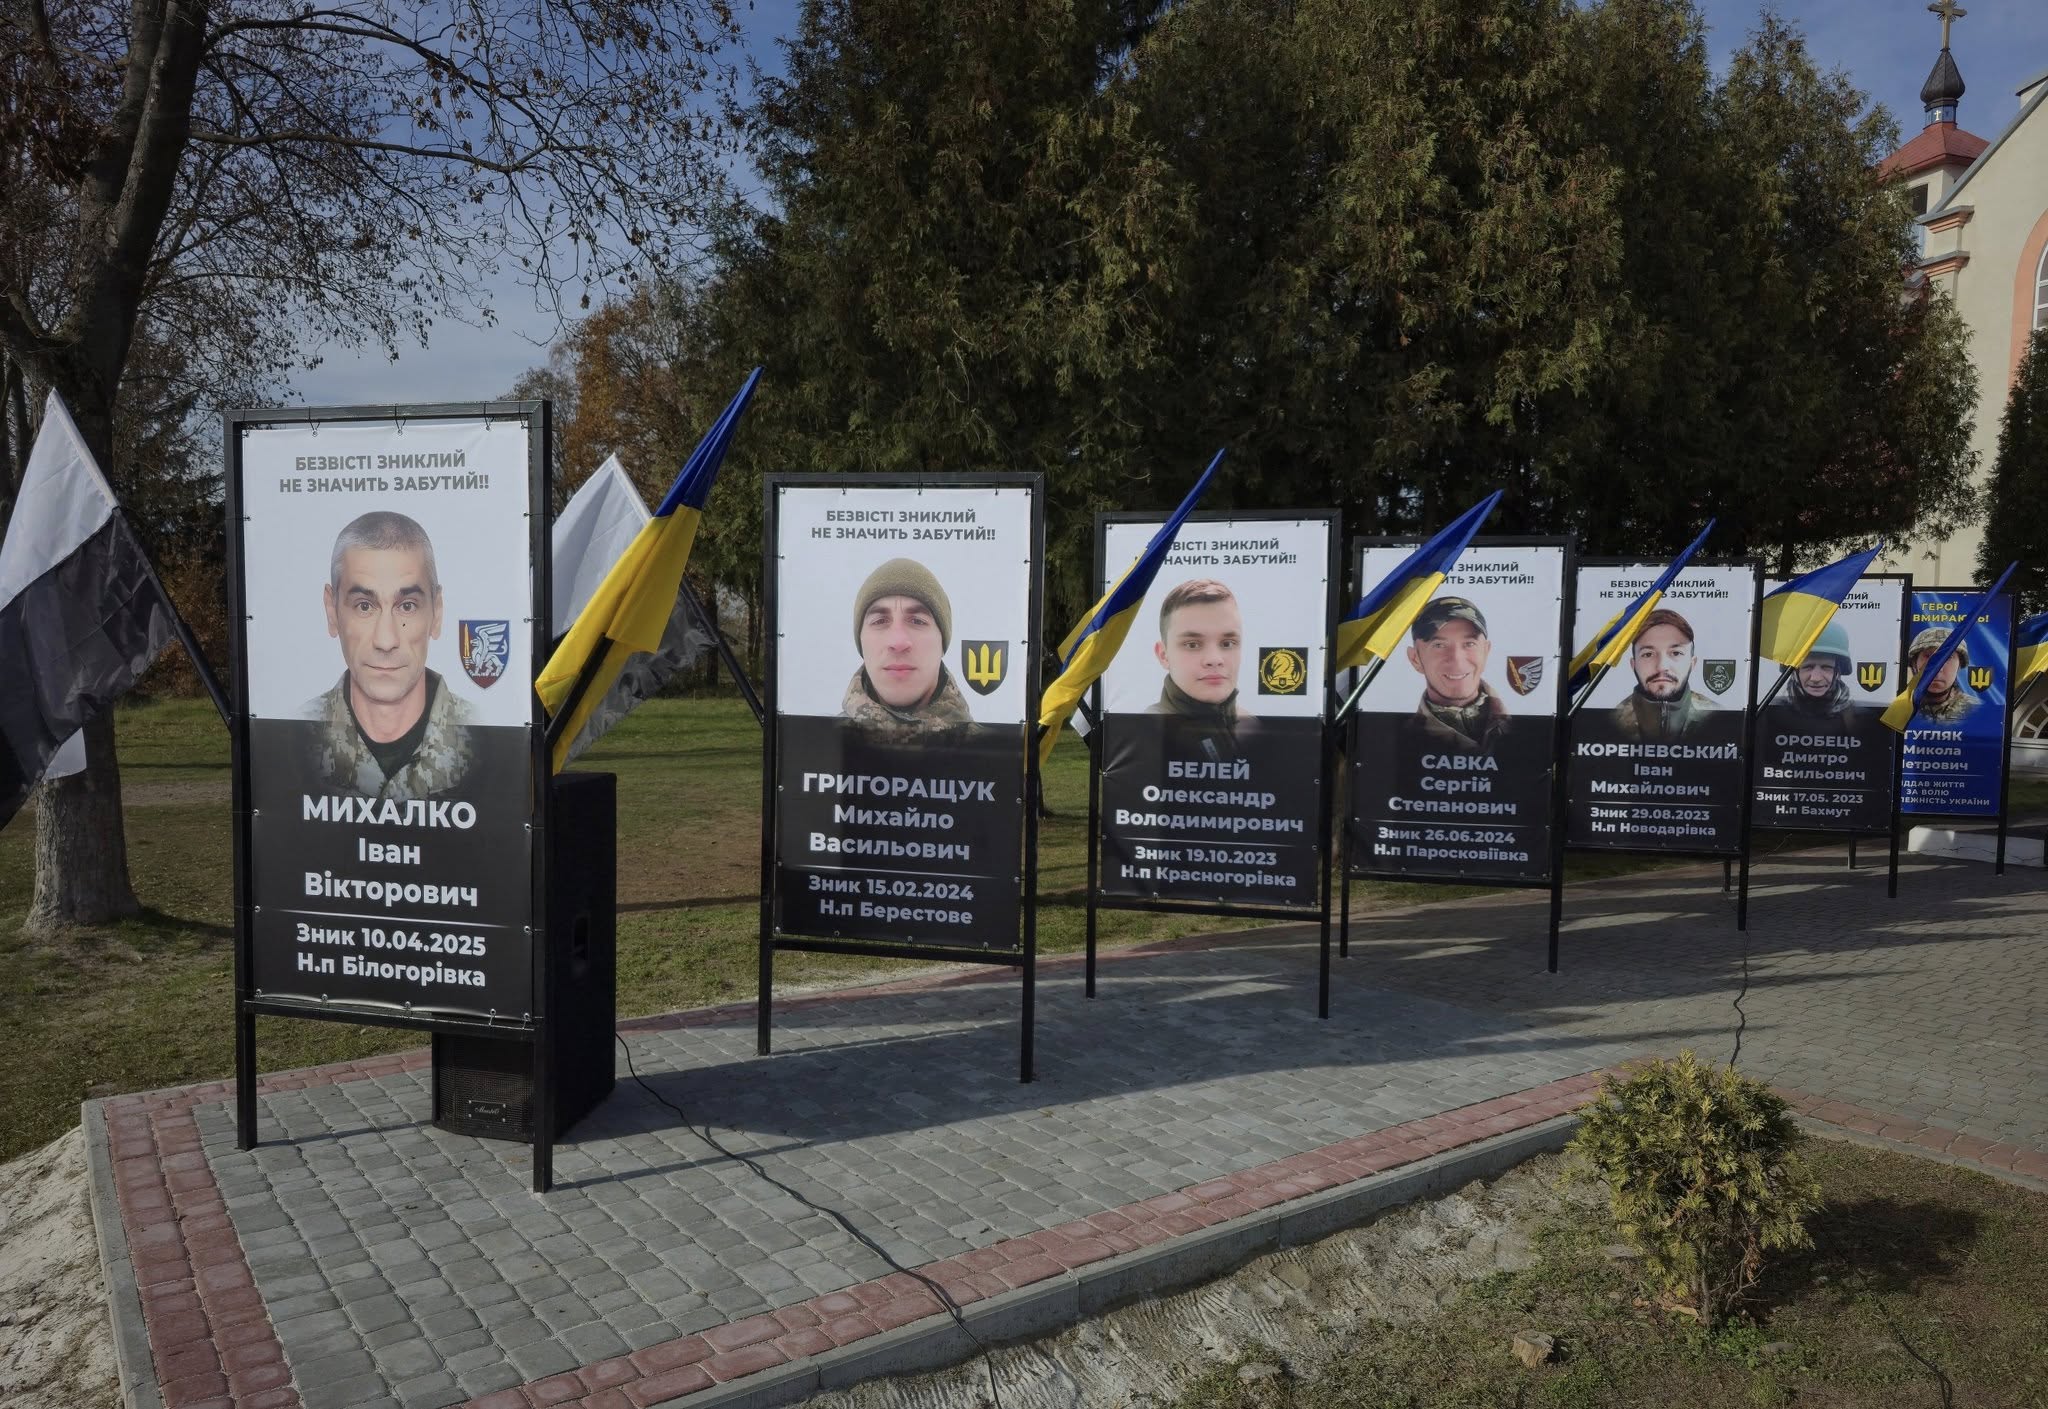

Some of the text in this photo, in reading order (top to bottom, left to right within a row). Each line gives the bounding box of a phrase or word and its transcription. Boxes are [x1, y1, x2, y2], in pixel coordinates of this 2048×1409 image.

[295, 449, 466, 471] БЕЗВІСТІ ЗНИКЛИЙ
[279, 471, 489, 493] НЕ ЗНАЧИТЬ ЗАБУТИЙ!!
[826, 509, 976, 523] БЕЗВІСТІ ЗНИКЛИЙ
[811, 526, 996, 541] НЕ ЗНАЧИТЬ ЗАБУТИЙ!!
[1173, 538, 1280, 551] ВІСТІ ЗНИКЛИЙ
[1164, 552, 1297, 565] НАЧИТЬ ЗАБУТИЙ!!
[1458, 562, 1519, 572] ЗНИКЛИЙ
[1468, 574, 1534, 585] ЗАБУТИЙ!!
[1610, 579, 1716, 588] БЕЗВІСТ НИКЛИЙ
[1600, 591, 1614, 599] НЕ
[1670, 589, 1729, 599] ЗАБУТИЙ!!
[1841, 601, 1881, 610] БУТИЙ!!
[1921, 601, 1958, 611] ГЕРОЇ
[1775, 734, 1862, 750] ОРОБЕЦЬ
[1904, 730, 1963, 742] ГУГЛЯК
[1577, 743, 1739, 760] КОРЕНЕВСЬКИЙ
[1903, 744, 1962, 756] Микола
[1421, 754, 1499, 771] САВКА
[1781, 751, 1849, 766] Дмитро
[1168, 758, 1251, 780] БЕЛЕЙ
[1634, 763, 1673, 776] Іван
[1763, 767, 1866, 781] Васильович
[803, 772, 996, 803] ГРИГОРАЩУК
[1420, 776, 1492, 795] Сергій
[1591, 780, 1710, 796] Михайлович
[1906, 788, 1950, 797] ЗА ВОЛЮ
[1933, 781, 1966, 789] ЖИТТЯ
[1142, 785, 1277, 809] Олександр
[1756, 791, 1790, 802] Зник
[1832, 794, 1864, 804] 2023
[1949, 797, 1990, 806] УКРАЇНИ
[303, 795, 477, 829] МИХАЛКО
[1388, 797, 1517, 815] Степанович
[1590, 807, 1711, 821] Зник 29.08.2023
[1775, 805, 1851, 818] Н.п Бахмут
[834, 804, 955, 829] Михайло
[1116, 809, 1305, 834] Володимирович
[1378, 827, 1516, 844] Зник 26.06.2024
[1591, 821, 1717, 837] Н.п Новодарівка
[359, 838, 421, 865] Іван
[809, 832, 970, 860] Васильович
[1374, 844, 1529, 862] Н.п Паросковіївка
[1135, 846, 1278, 866] Зник 19.10.2023
[1121, 865, 1297, 887] Н.п Красногорівка
[305, 870, 478, 907] Вікторович
[808, 875, 975, 901] Зник 15.02.2024
[819, 899, 974, 924] Н.п Берестове
[296, 923, 487, 956] Зник 10.04.2025
[297, 952, 486, 987] Н.п Білогорівка
